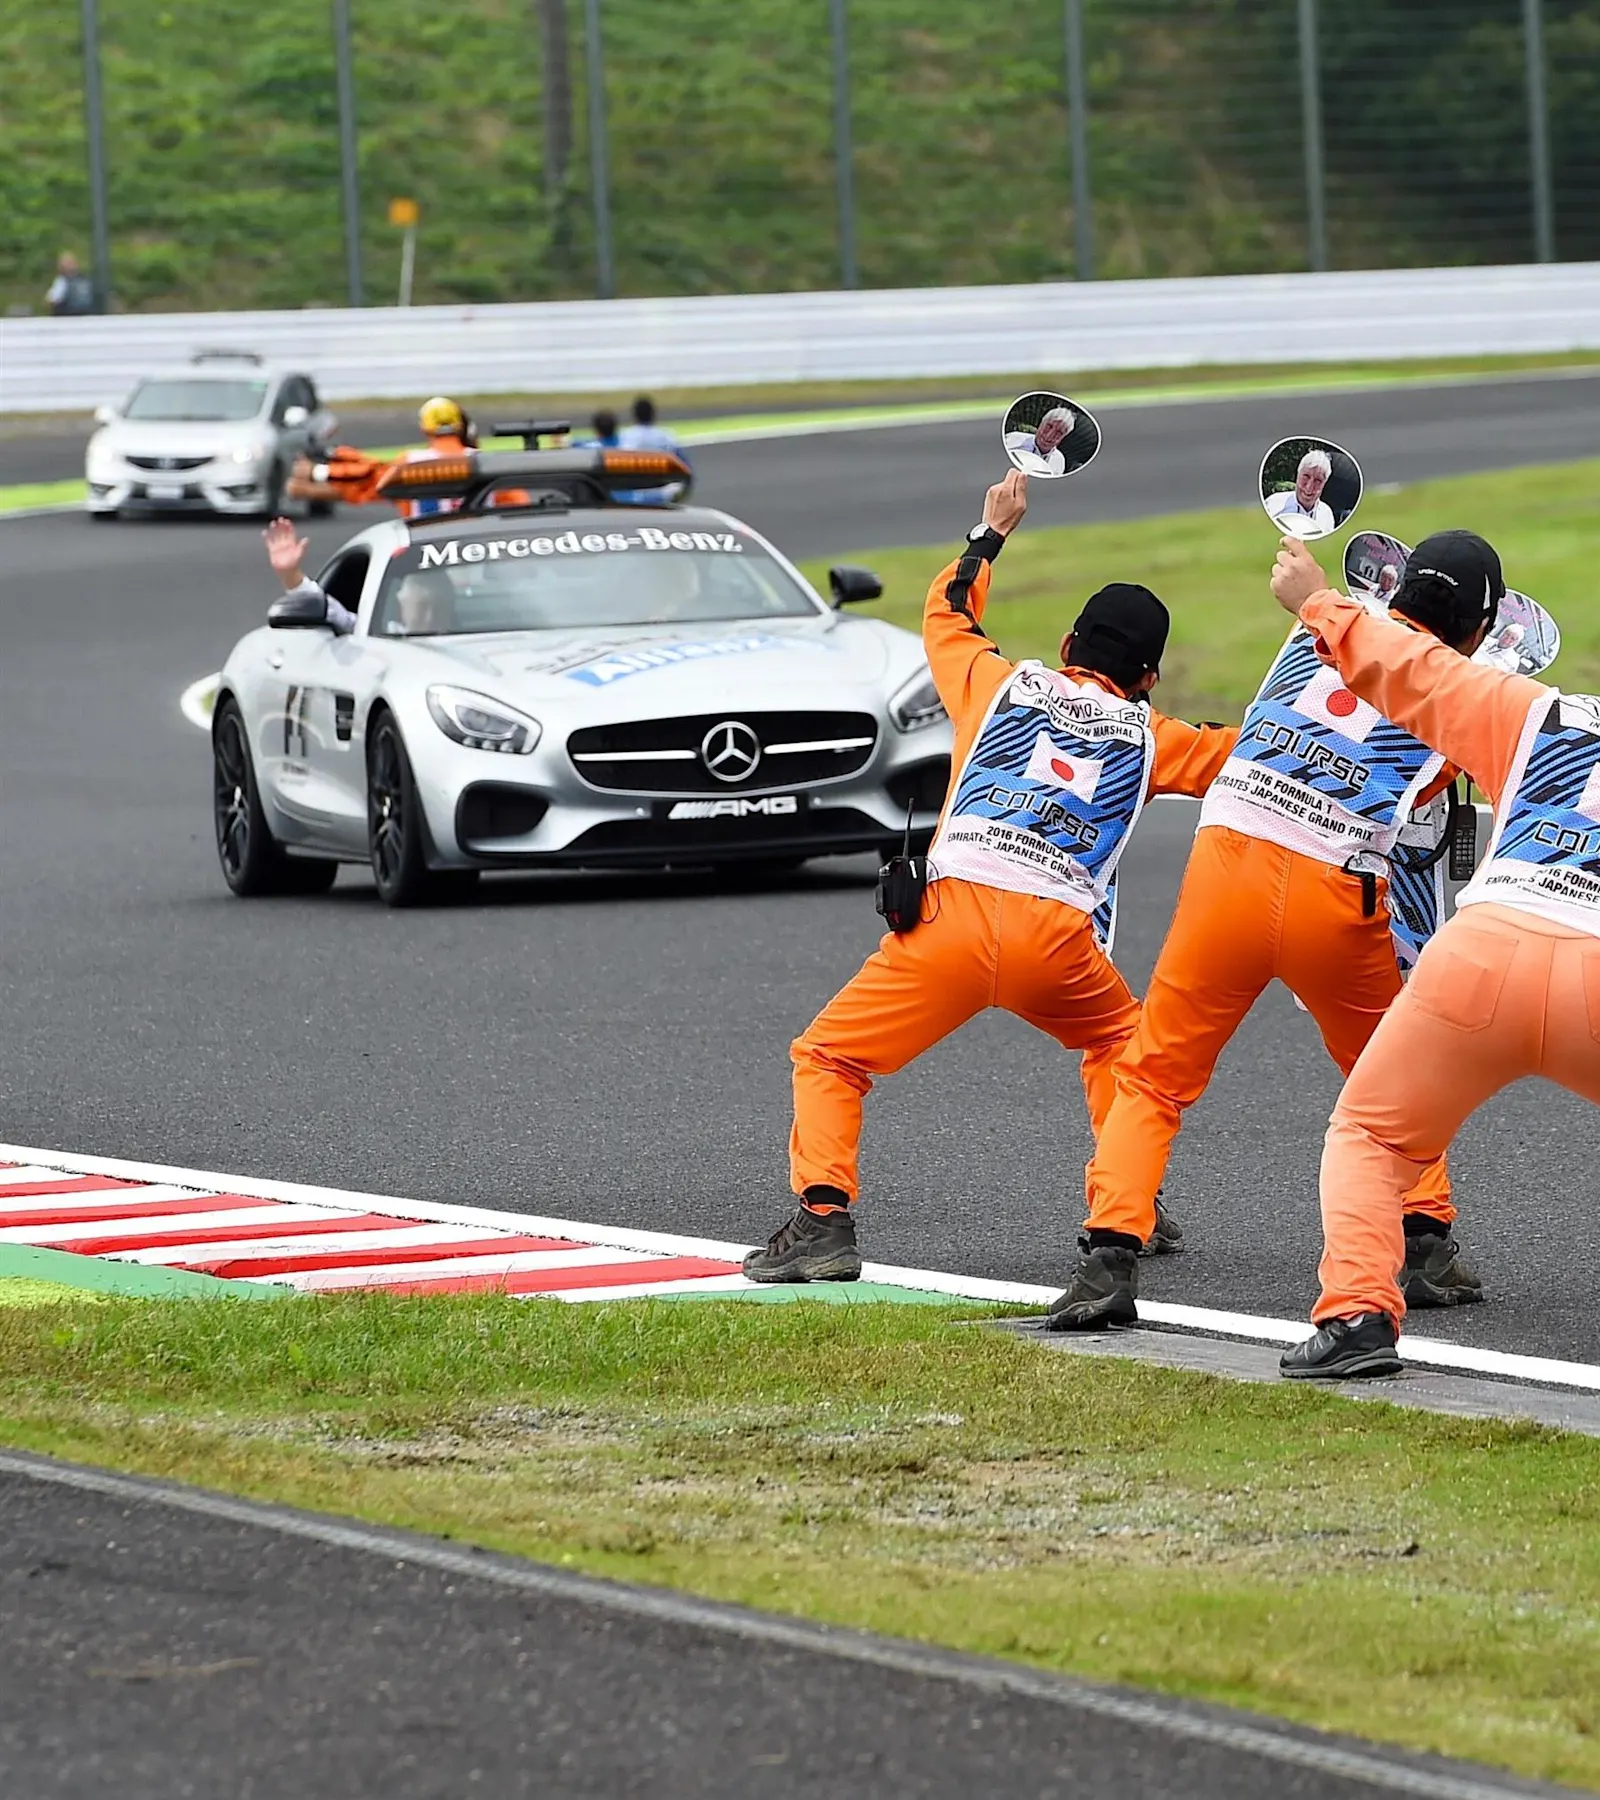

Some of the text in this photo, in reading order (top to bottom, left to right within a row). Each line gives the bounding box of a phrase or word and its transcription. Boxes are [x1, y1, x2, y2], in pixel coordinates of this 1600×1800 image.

[418, 528, 743, 569] Mercedes-Benz
[1034, 697, 1134, 739] INTVENTION MARSHAL
[1253, 718, 1371, 793] COURSE
[710, 795, 798, 819] AMG
[1246, 769, 1333, 815] 2016 FORMULA 1
[986, 786, 1101, 851] COURSE
[1250, 786, 1308, 819] JAPANESE
[1308, 811, 1346, 835] GRAND
[1348, 826, 1375, 843] PRIX
[986, 825, 1013, 841] 2016
[1015, 833, 1064, 861] FORMULA
[993, 841, 1050, 866] JAPANESE
